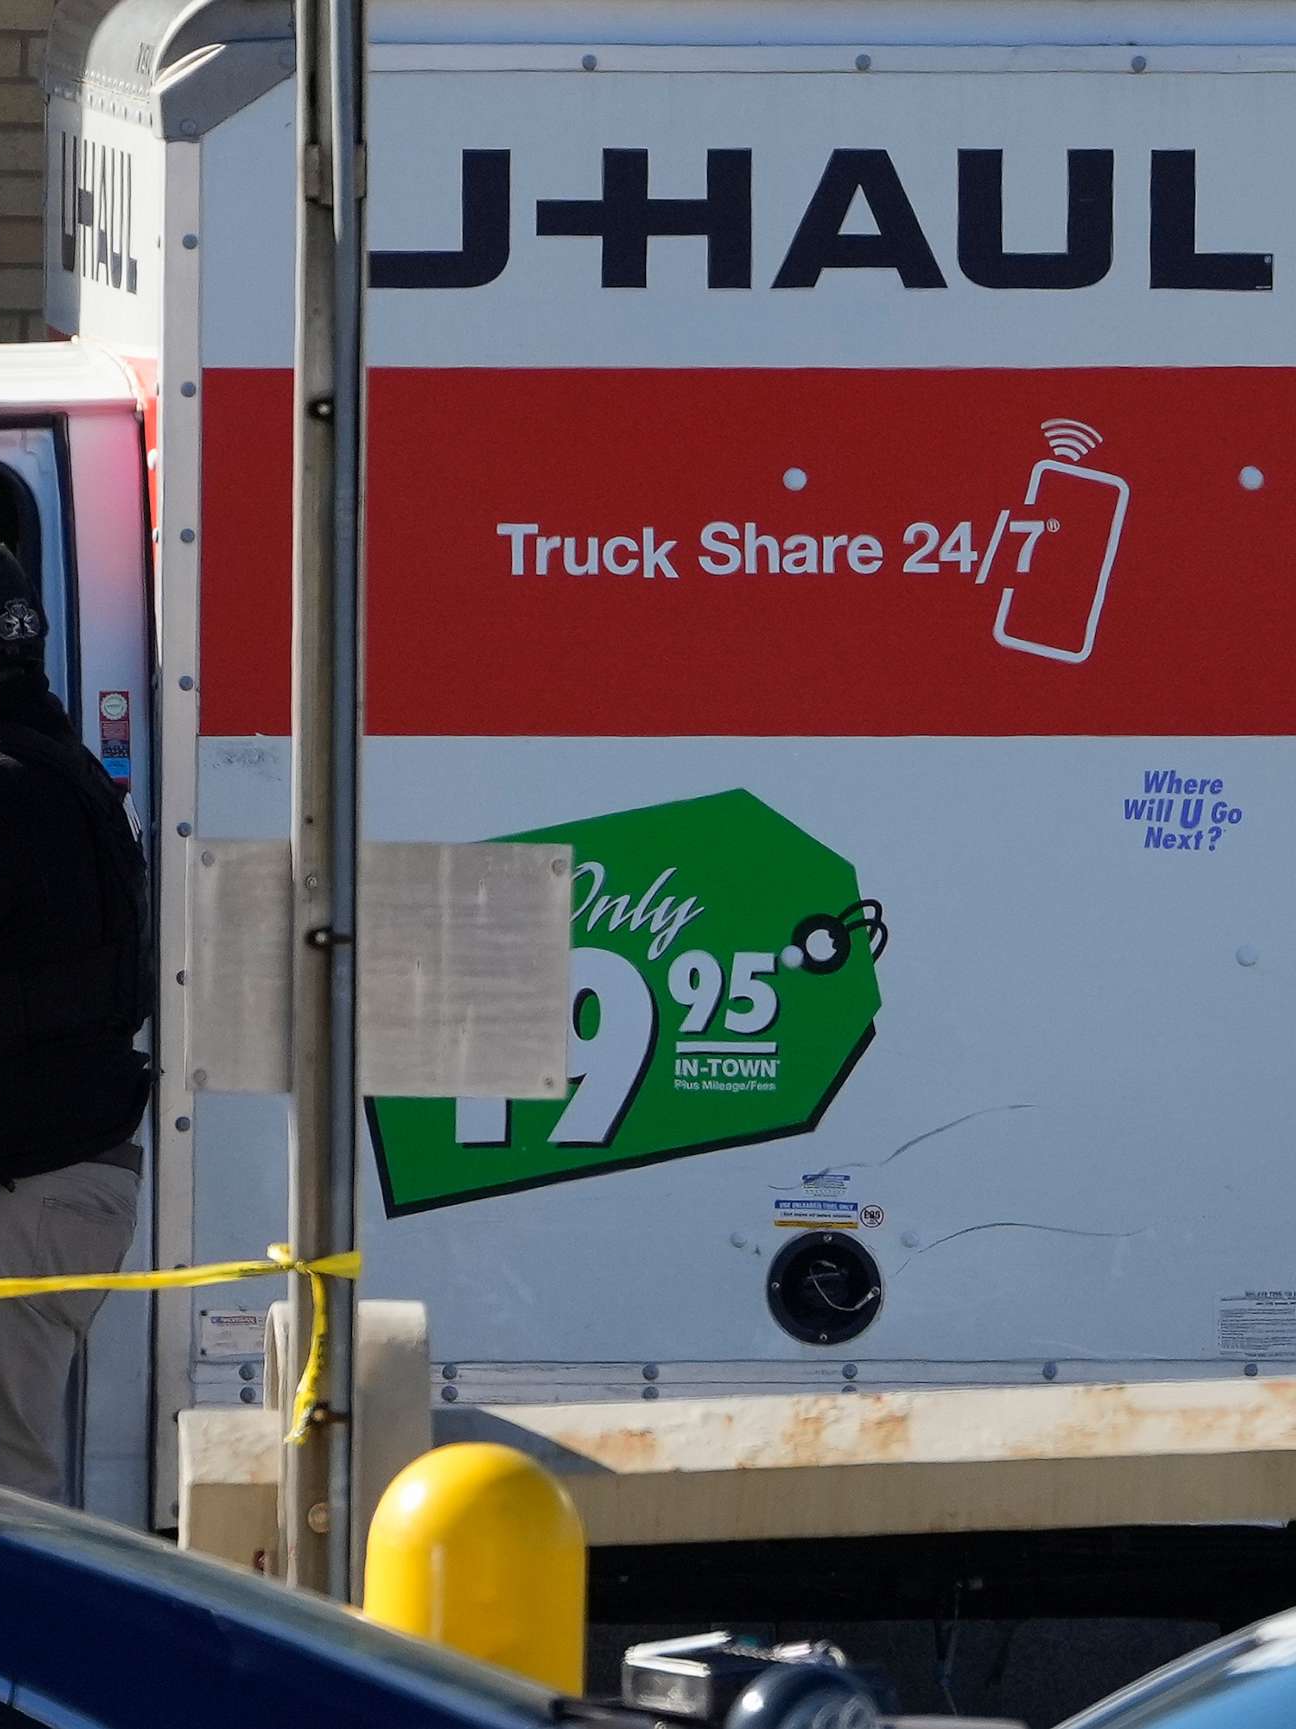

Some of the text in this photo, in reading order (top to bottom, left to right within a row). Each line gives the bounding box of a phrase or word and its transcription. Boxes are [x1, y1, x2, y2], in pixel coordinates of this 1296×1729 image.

[61, 131, 137, 295] U-HAUL
[497, 523, 679, 578] Truck
[698, 521, 884, 575] Share
[1144, 769, 1223, 795] Where
[1124, 799, 1243, 829] Will U Go
[668, 949, 780, 1034] 95
[674, 1058, 777, 1077] IN-TOWN
